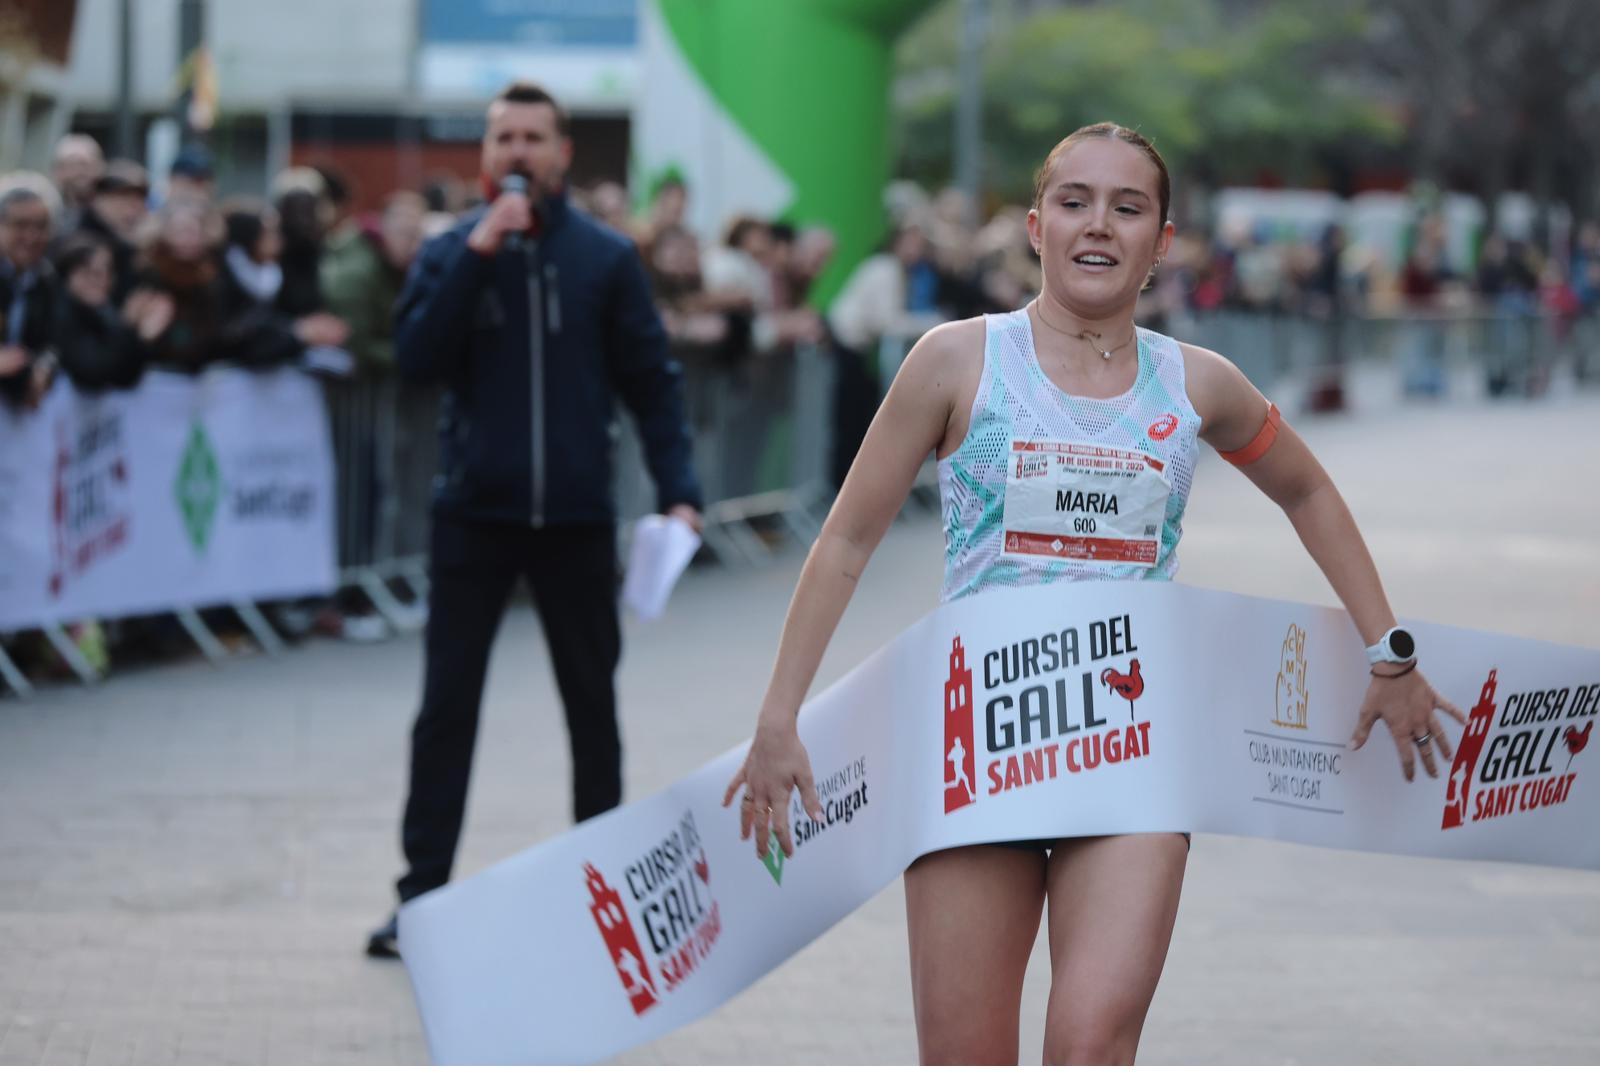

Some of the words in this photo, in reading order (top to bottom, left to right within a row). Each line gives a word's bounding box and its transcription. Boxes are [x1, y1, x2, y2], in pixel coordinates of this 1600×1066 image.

[1055, 490, 1119, 515] MARIA
[1073, 517, 1096, 534] 600
[984, 628, 1080, 689] CURSA
[1089, 614, 1138, 661] DEL
[985, 672, 1107, 752] GALL
[1499, 687, 1570, 728] CURSA
[853, 755, 866, 780] DE
[987, 743, 1059, 795] SANT
[1066, 720, 1151, 773] CUGAT
[1249, 741, 1271, 765] CLUB
[1272, 746, 1342, 775] MUNTANYENC
[1480, 725, 1561, 783] GALL
[794, 780, 868, 847] SanCugat
[1291, 776, 1322, 801] CUGAT
[1472, 782, 1520, 822] SANT
[1519, 772, 1577, 813] CUGAT
[642, 866, 704, 955] GALL
